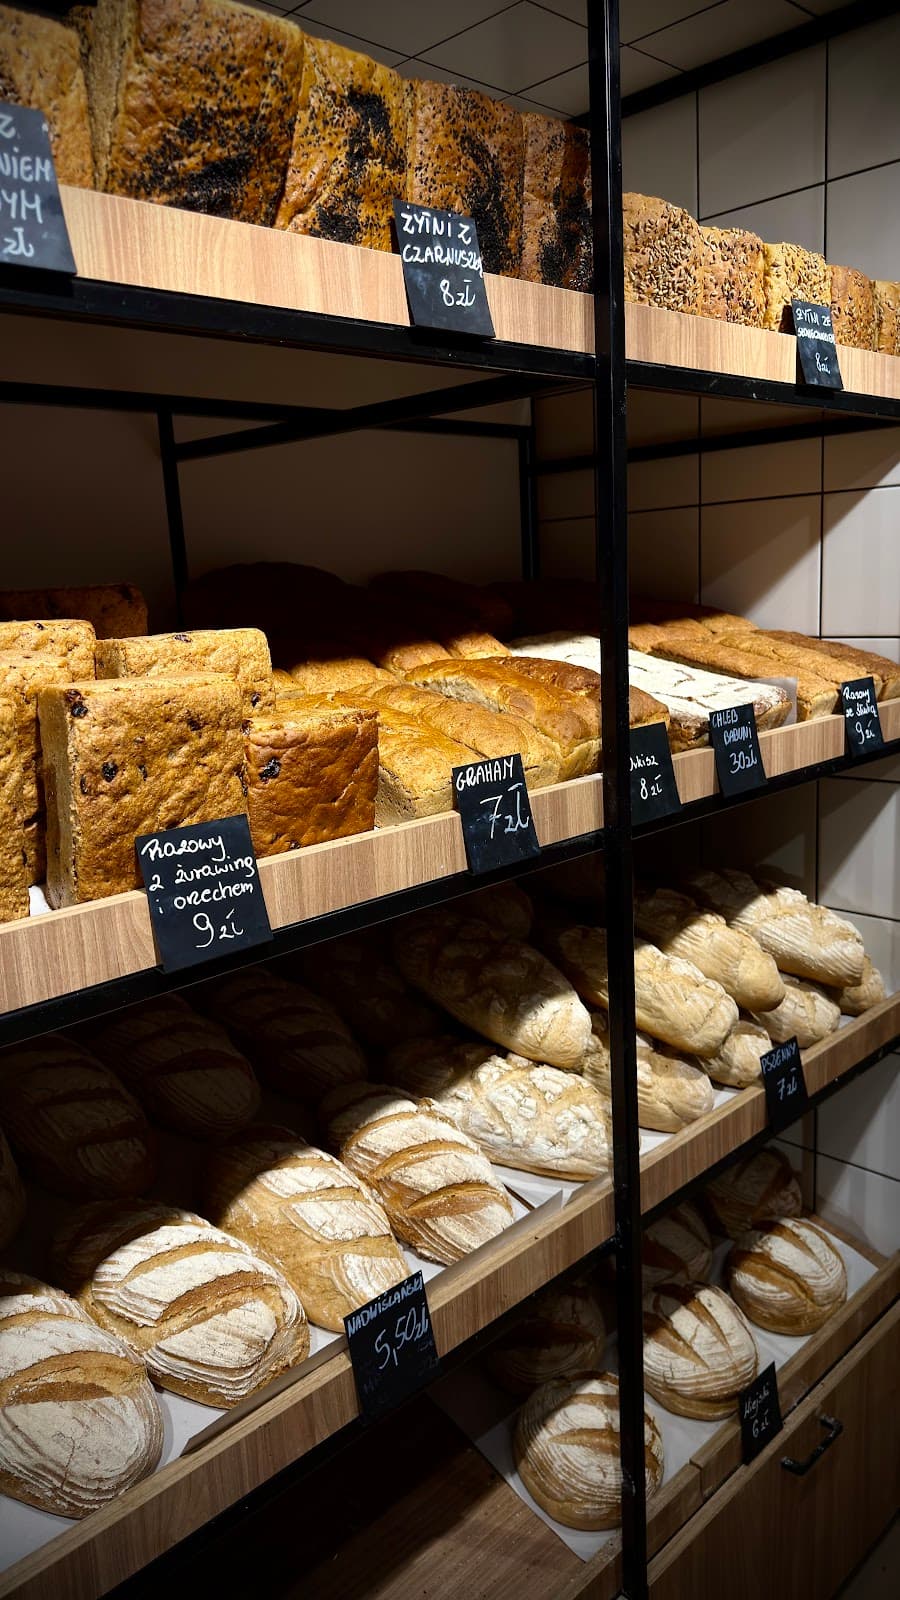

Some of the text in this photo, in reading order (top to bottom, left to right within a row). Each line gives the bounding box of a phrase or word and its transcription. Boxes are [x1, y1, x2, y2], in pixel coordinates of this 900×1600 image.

[711, 708, 739, 729] CHLEB
[456, 756, 514, 792] GRAHAM
[140, 835, 227, 862] Razowy
[173, 881, 254, 910] orzechem
